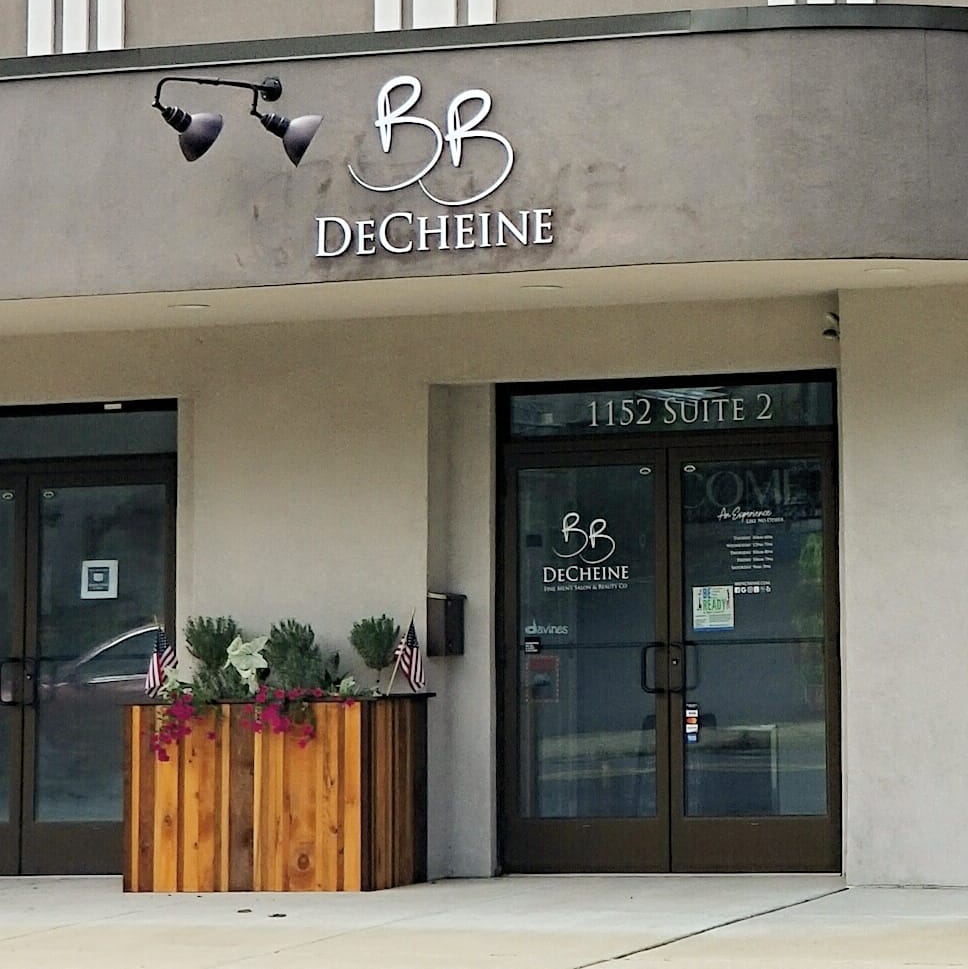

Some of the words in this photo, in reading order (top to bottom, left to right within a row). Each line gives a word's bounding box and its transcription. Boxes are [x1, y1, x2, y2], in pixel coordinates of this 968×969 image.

[587, 398, 652, 427] 1152
[663, 396, 746, 424] SUITE
[756, 393, 774, 420] 2
[525, 618, 568, 634] davines
